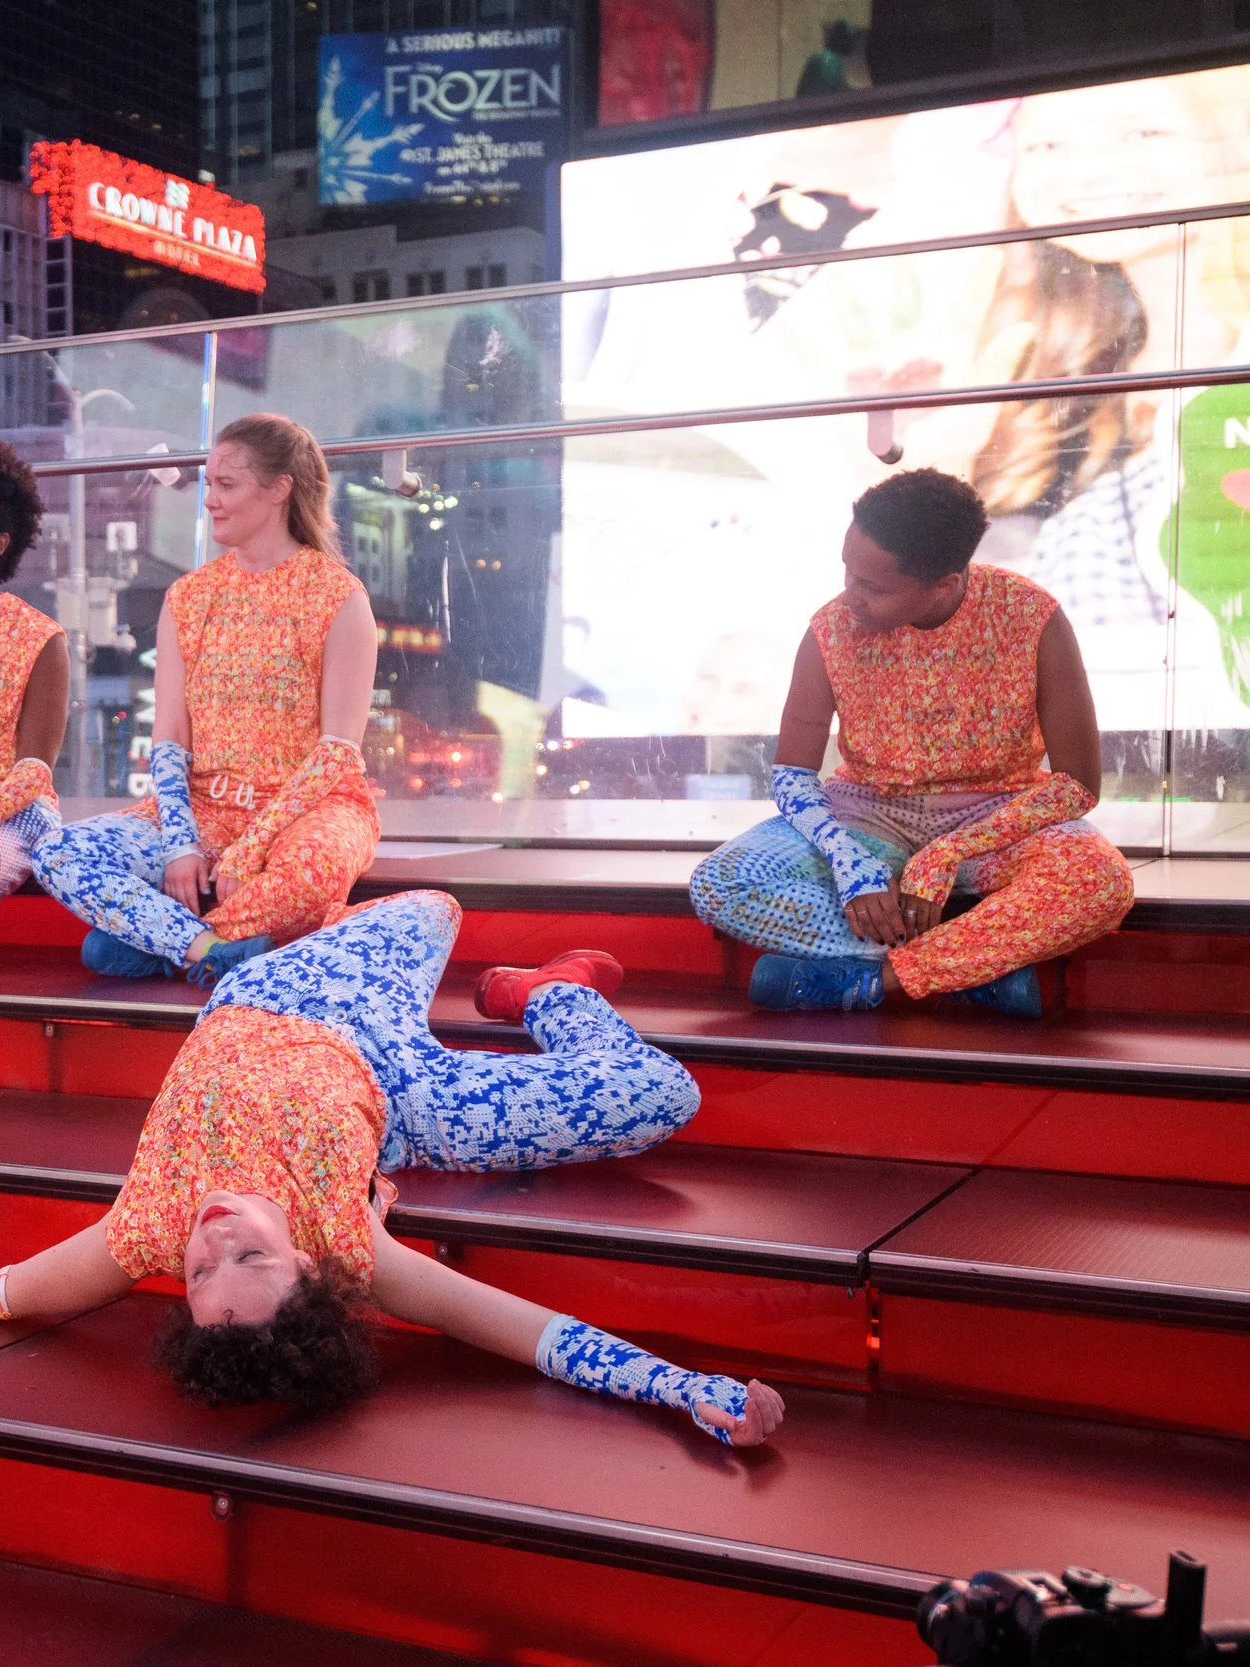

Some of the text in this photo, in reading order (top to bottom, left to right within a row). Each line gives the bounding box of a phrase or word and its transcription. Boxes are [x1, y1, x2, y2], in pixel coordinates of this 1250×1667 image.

[403, 31, 476, 53] SERIOUS
[385, 63, 562, 122] FROZEN
[437, 144, 482, 163] JAMES
[88, 181, 257, 262] CROWNE PLAZA
